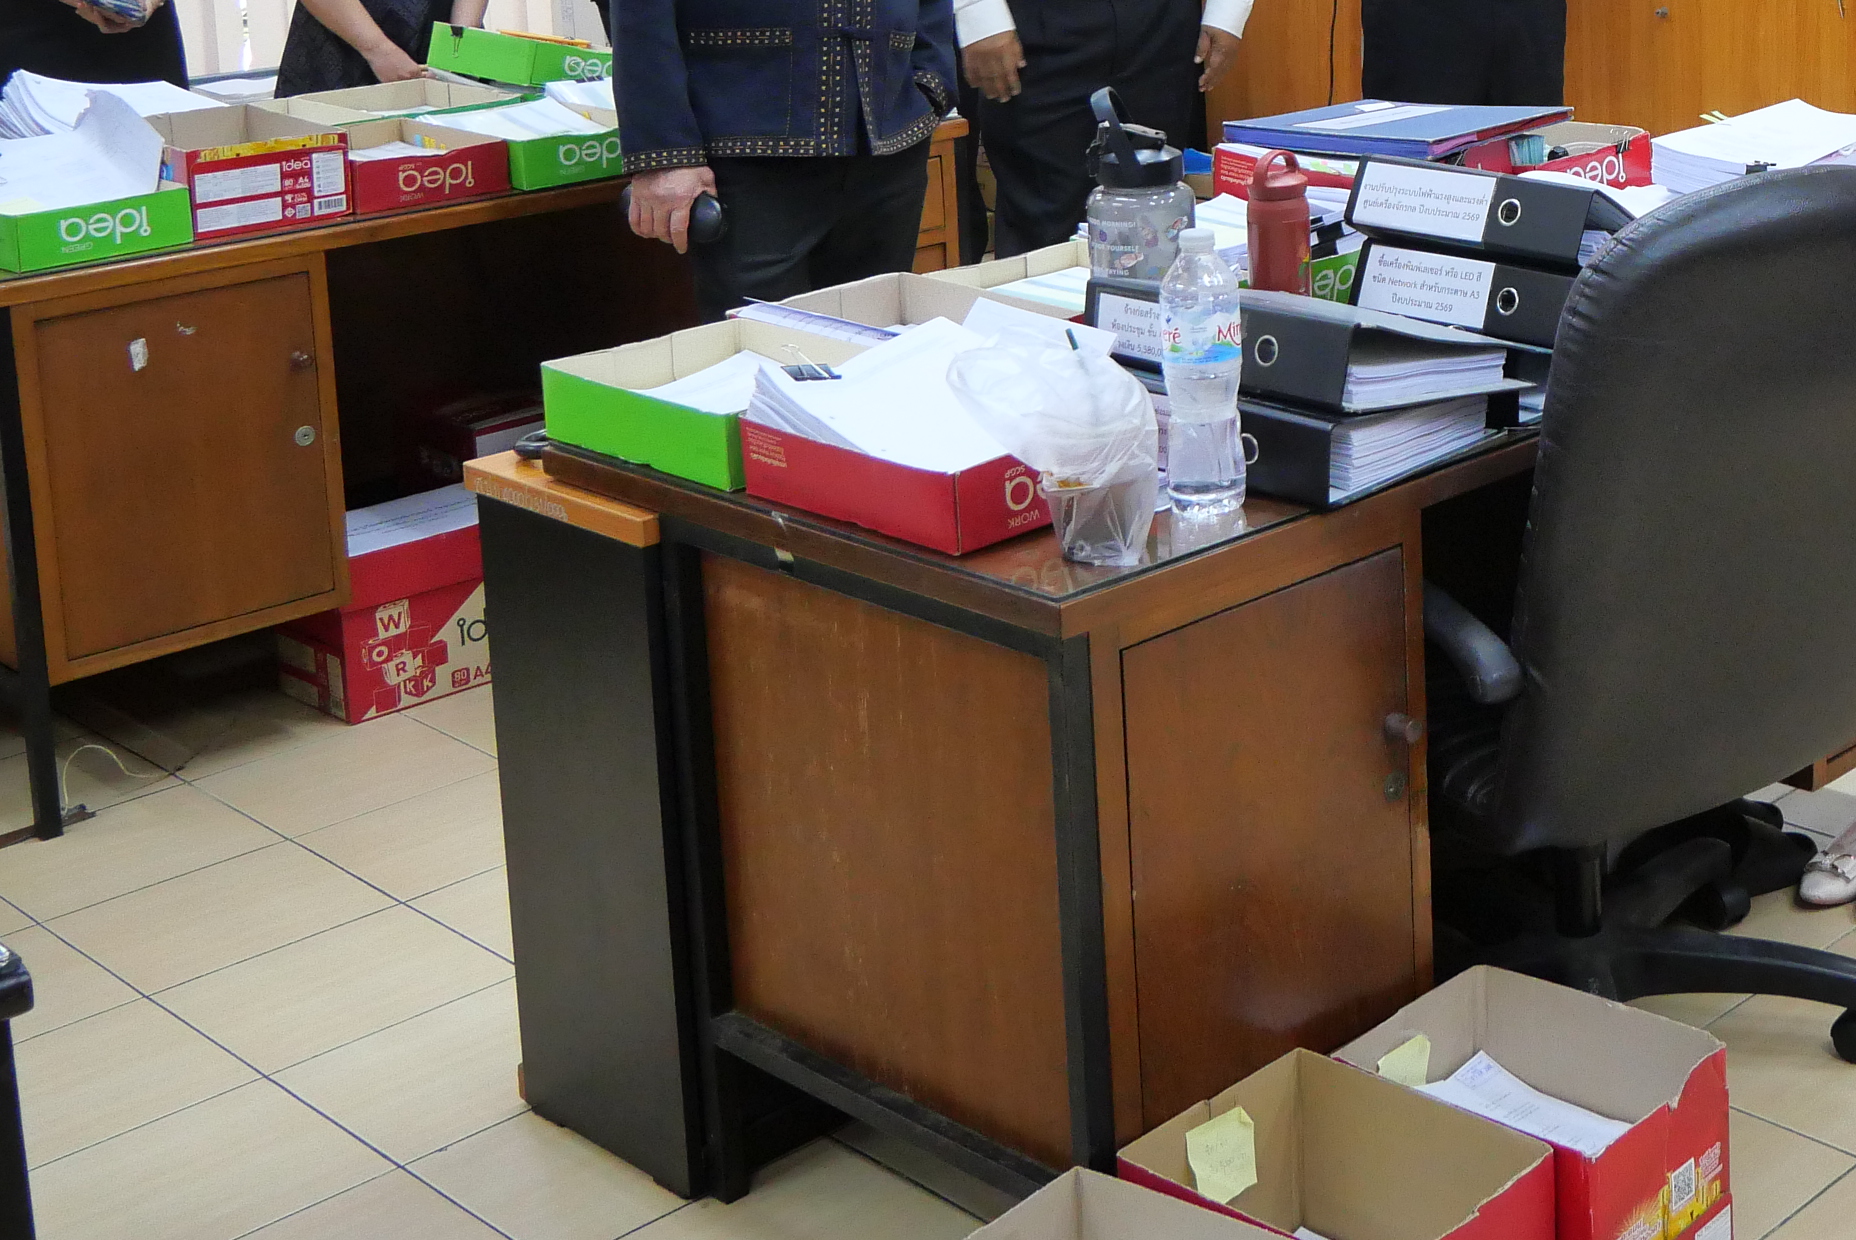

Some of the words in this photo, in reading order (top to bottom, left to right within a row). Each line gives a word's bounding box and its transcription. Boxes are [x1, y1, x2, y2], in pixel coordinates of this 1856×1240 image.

[558, 137, 621, 168] dea
[282, 159, 311, 172] idea
[399, 161, 474, 194] idea
[1418, 205, 1460, 219] ปีงบประมาณ
[1462, 213, 1480, 222] 2569
[60, 206, 152, 244] idea
[1445, 268, 1458, 279] หรือ
[1460, 271, 1475, 281] LED
[1476, 271, 1482, 282] สี
[1372, 273, 1386, 285] ชนิด
[1388, 277, 1418, 290] Network
[1419, 282, 1468, 298] สำหรับกระดาษ
[1470, 289, 1480, 299] A3
[1391, 293, 1433, 310] ปีงบประมาณ
[1435, 302, 1453, 312] 2569
[1005, 465, 1026, 478] SCGP
[1008, 509, 1040, 529] WORK
[455, 669, 467, 681] 80
